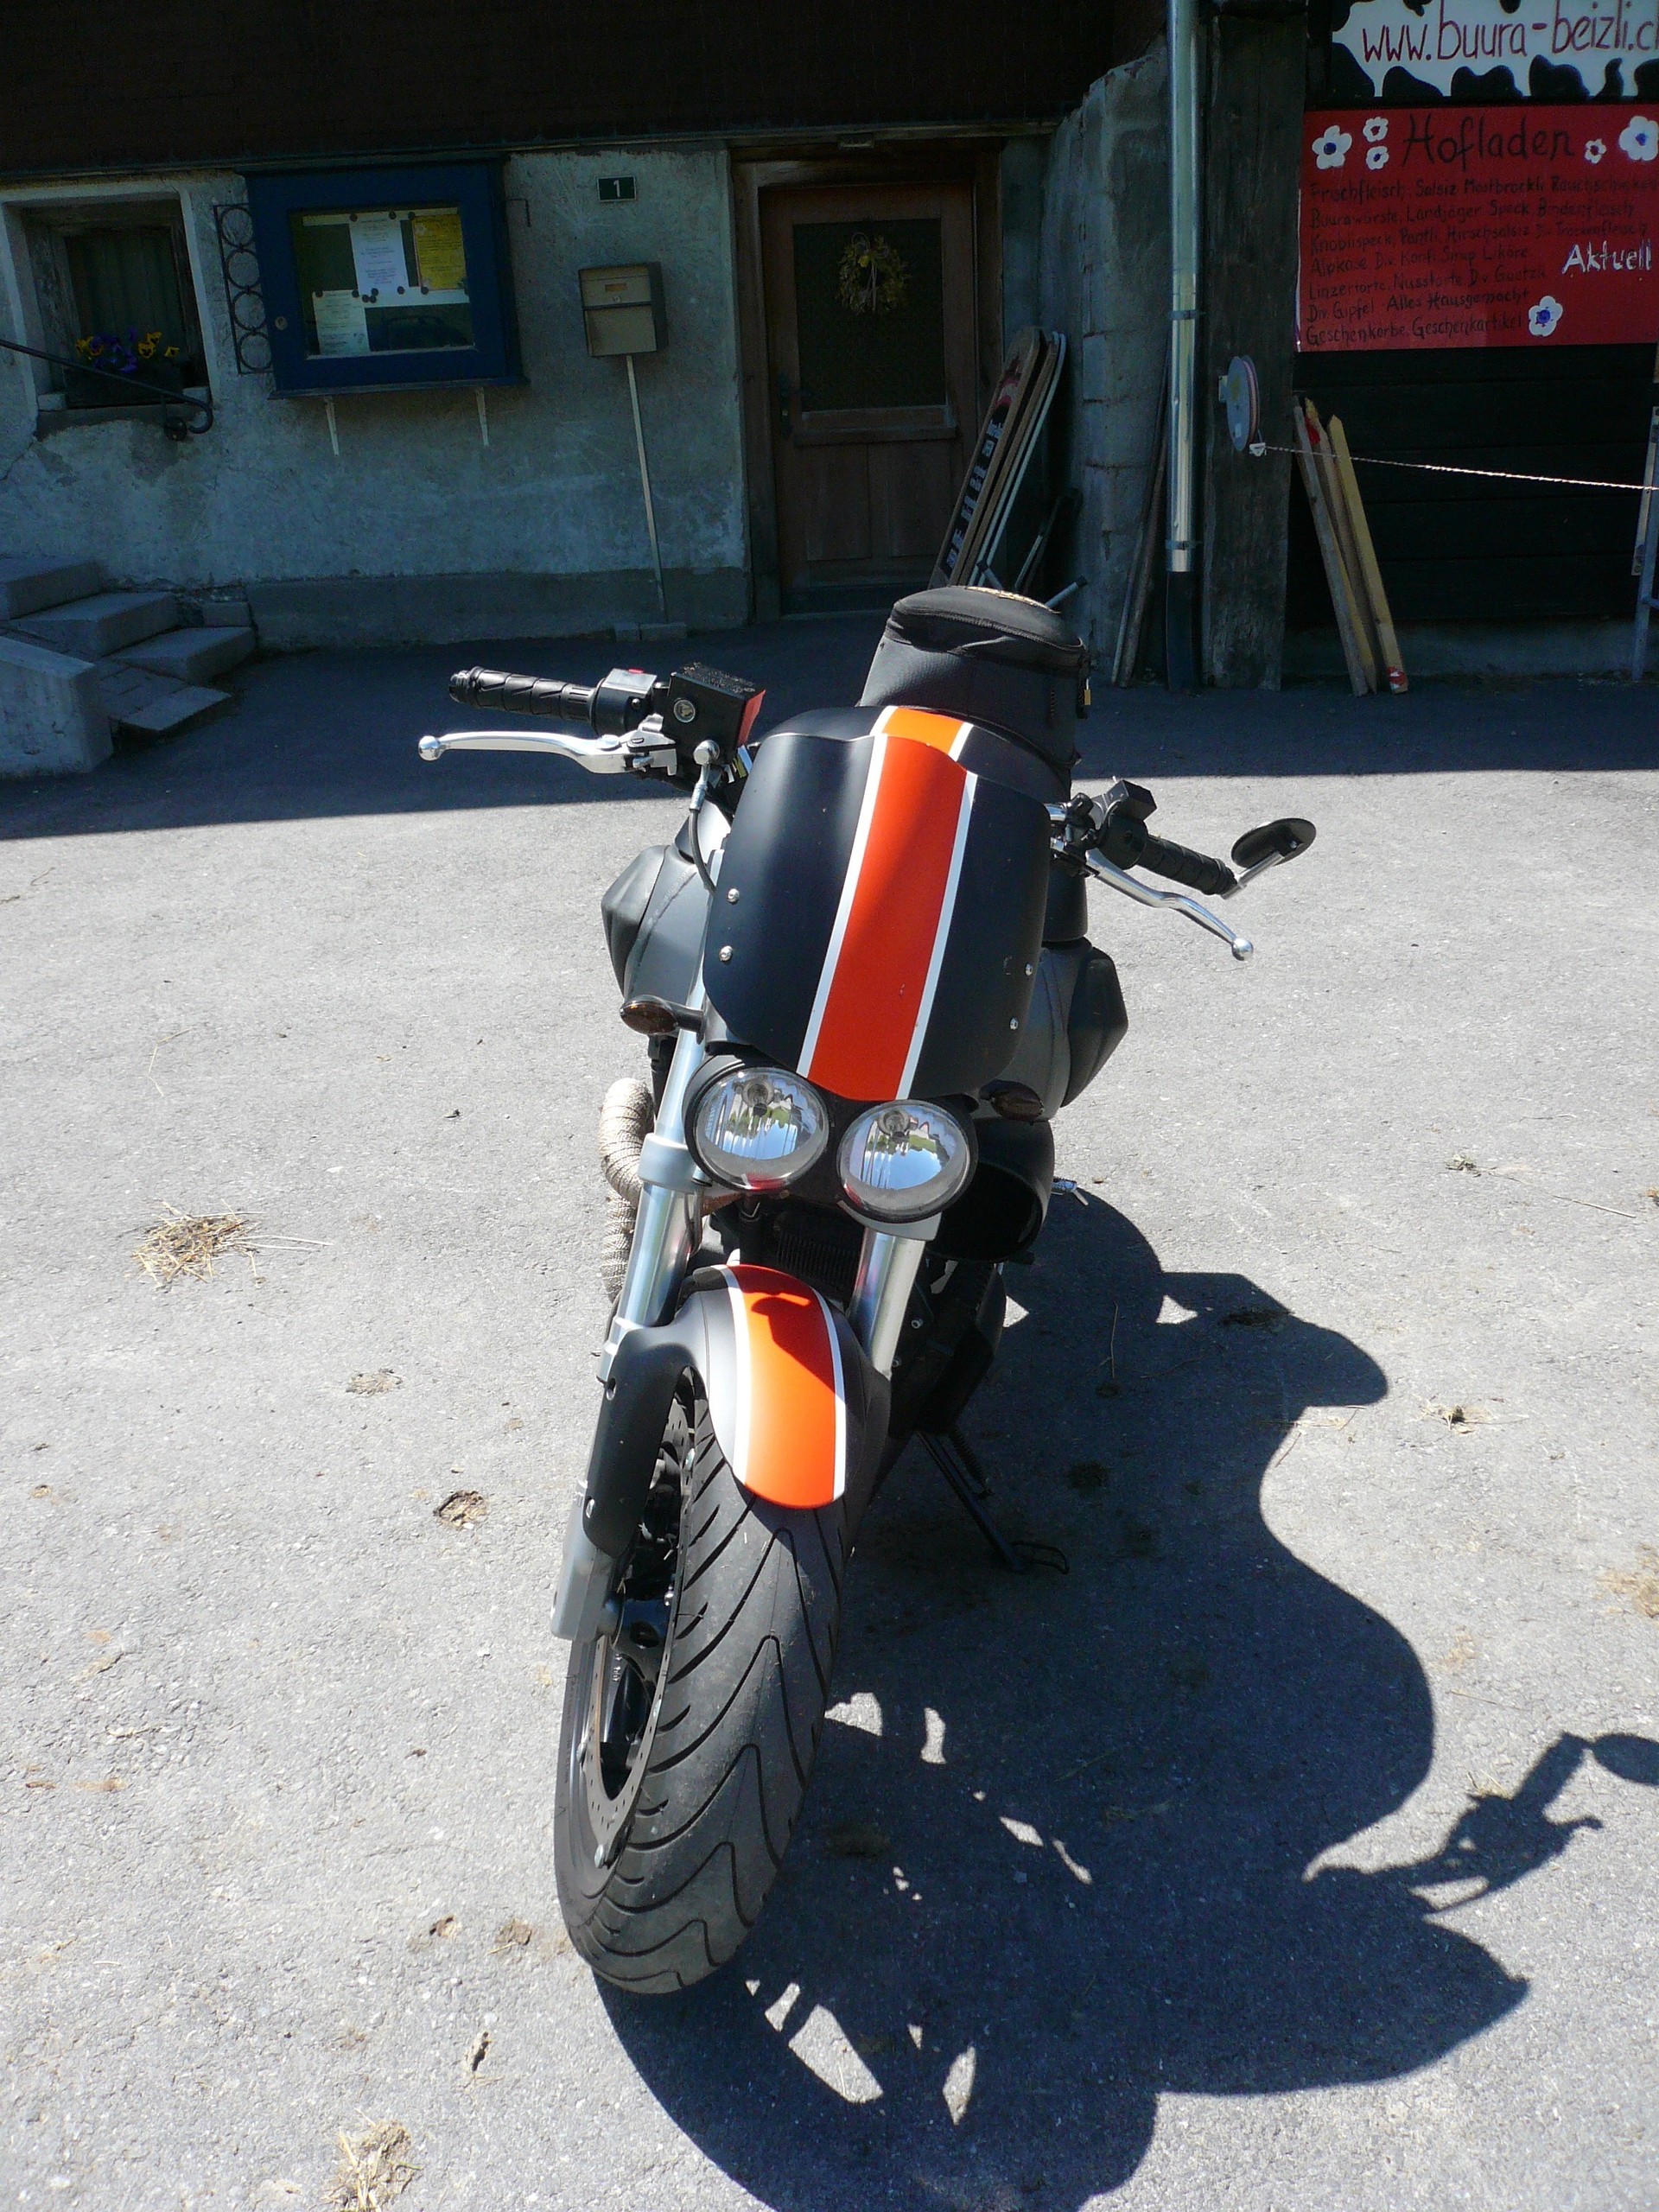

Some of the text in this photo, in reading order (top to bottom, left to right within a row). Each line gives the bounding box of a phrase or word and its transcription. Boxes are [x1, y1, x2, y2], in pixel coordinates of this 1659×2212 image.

[1362, 0, 1659, 62] www.buura-beizli.c
[1402, 112, 1576, 172] Hofladen
[612, 179, 621, 198] 1
[1561, 238, 1651, 275] Aktuell
[1332, 297, 1374, 324] Gipfel
[1387, 294, 1421, 312] Alles
